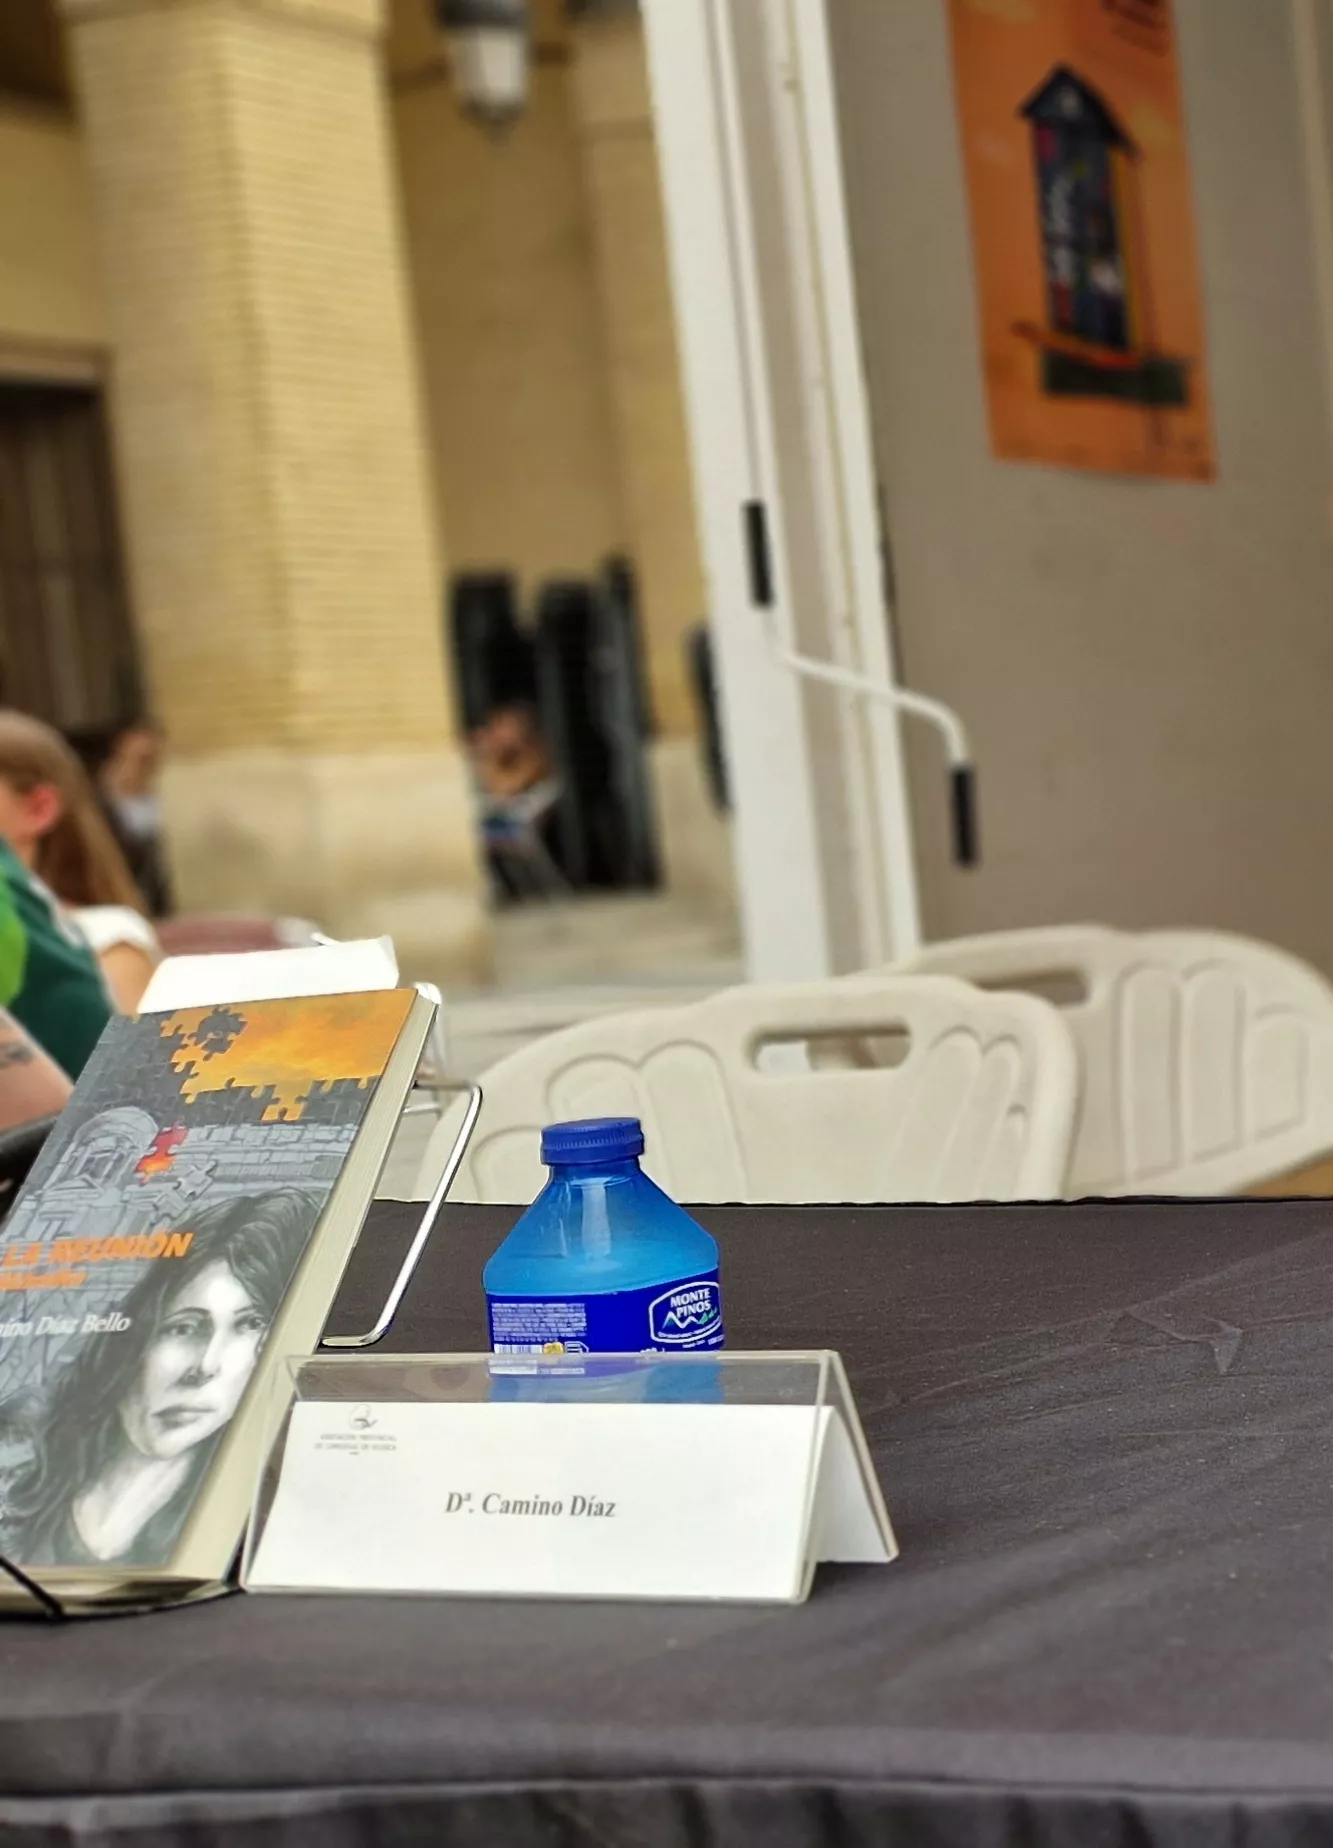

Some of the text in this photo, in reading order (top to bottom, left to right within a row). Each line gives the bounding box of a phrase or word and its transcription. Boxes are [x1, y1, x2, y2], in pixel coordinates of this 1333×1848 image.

[670, 1287, 712, 1308] MONTE
[677, 1299, 713, 1318] PINOS
[80, 1312, 132, 1333] Bello
[481, 1492, 564, 1517] Camino
[569, 1494, 618, 1518] Díaz
